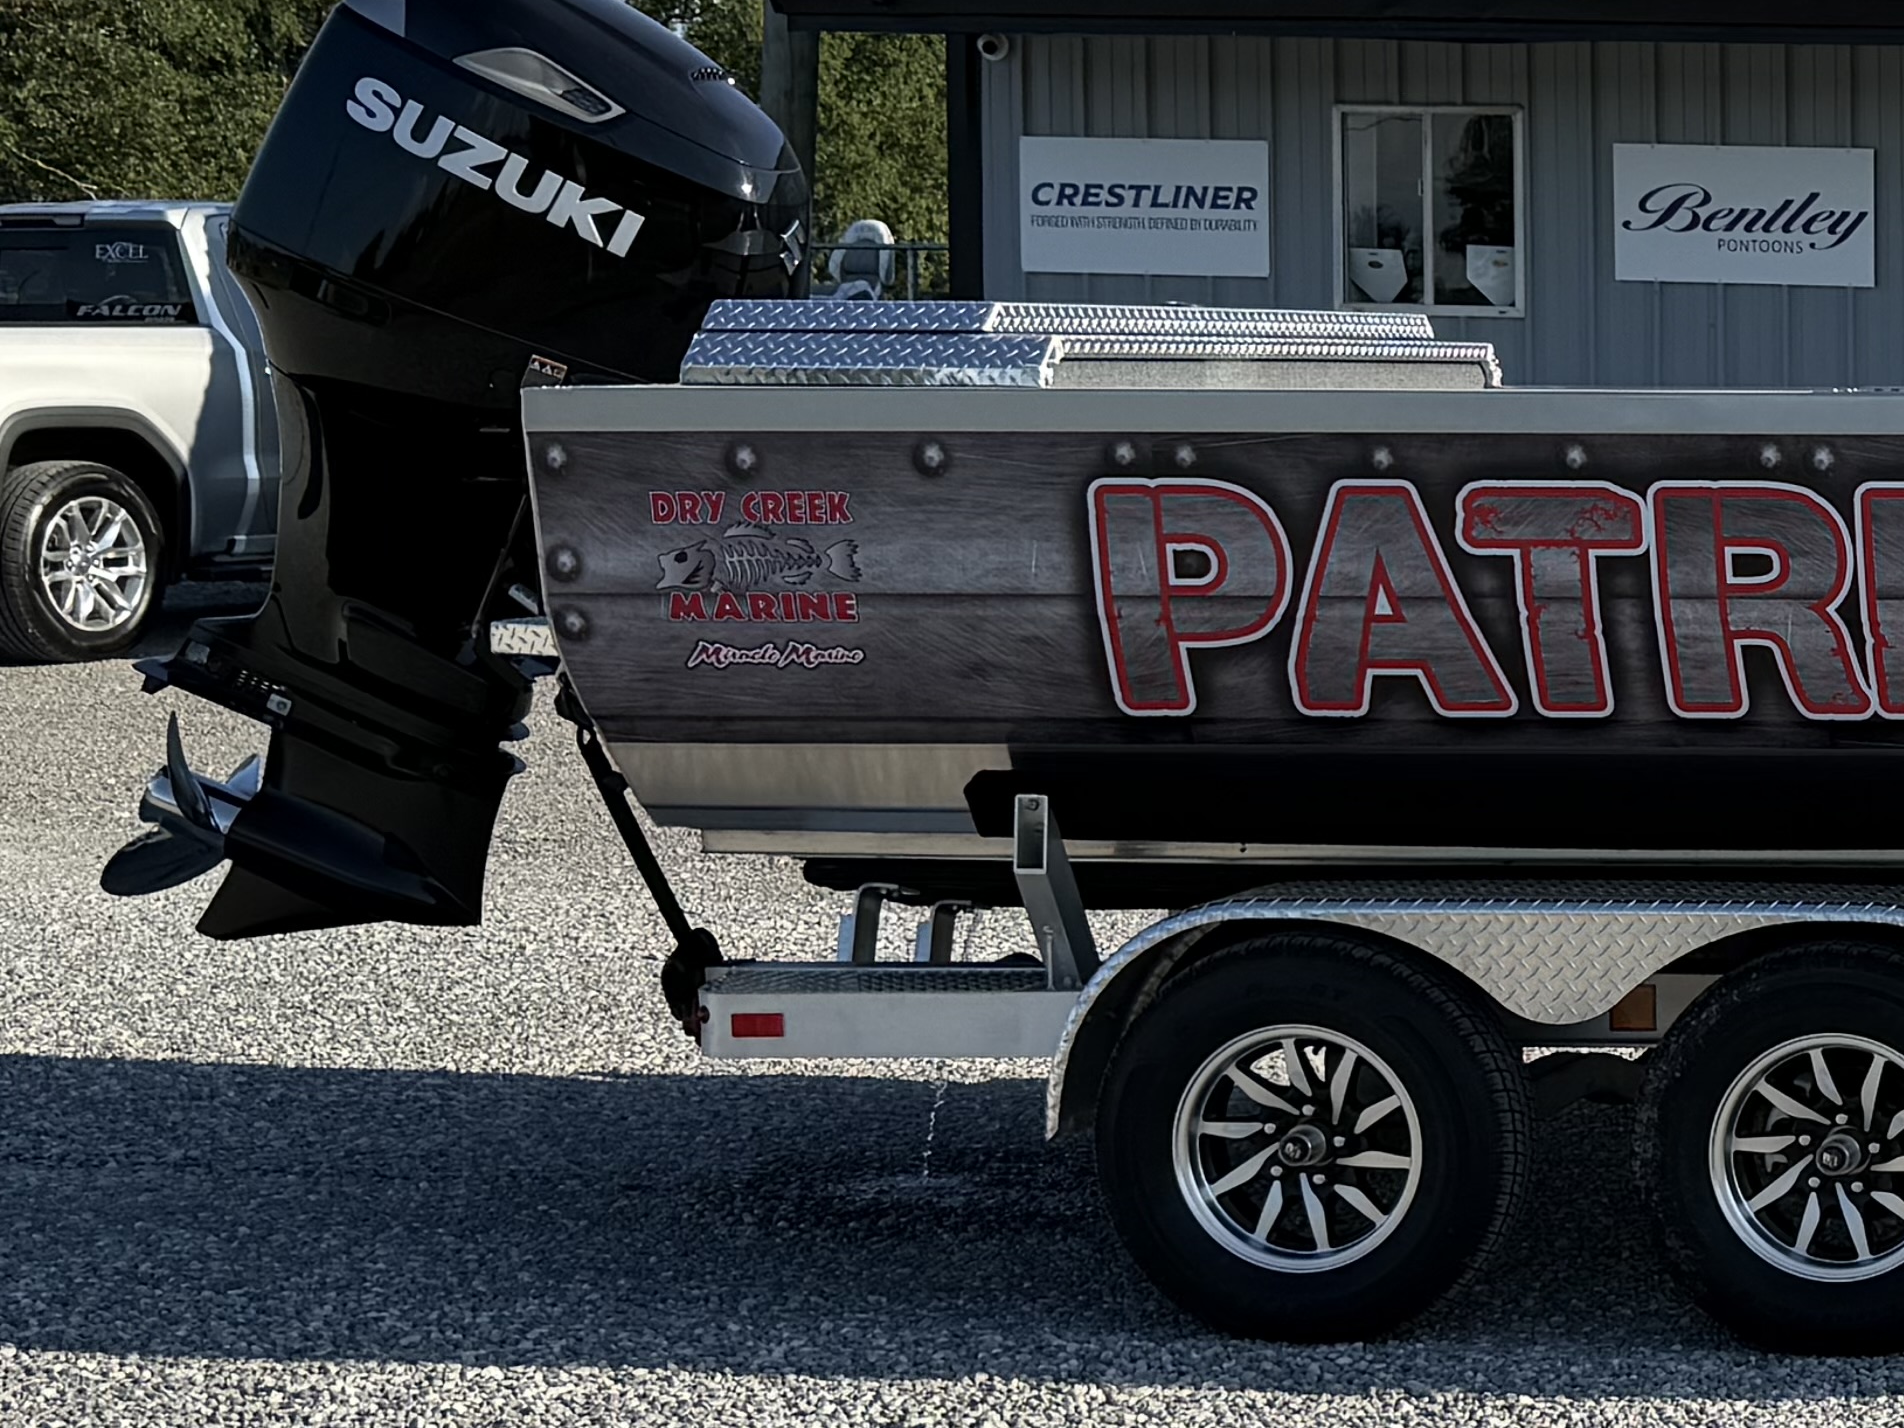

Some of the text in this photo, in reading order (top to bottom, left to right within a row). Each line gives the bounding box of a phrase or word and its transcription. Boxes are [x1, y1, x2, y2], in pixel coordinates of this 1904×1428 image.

[346, 76, 646, 258] SUZUKI
[1031, 182, 1258, 211] CRESTLINER
[1621, 182, 1869, 251] Bentley
[95, 241, 149, 260] EXCEL
[1717, 238, 1803, 254] PONTOONS
[76, 304, 182, 316] FALCON
[649, 491, 854, 524] DRY CREEK
[669, 592, 860, 623] MARINE
